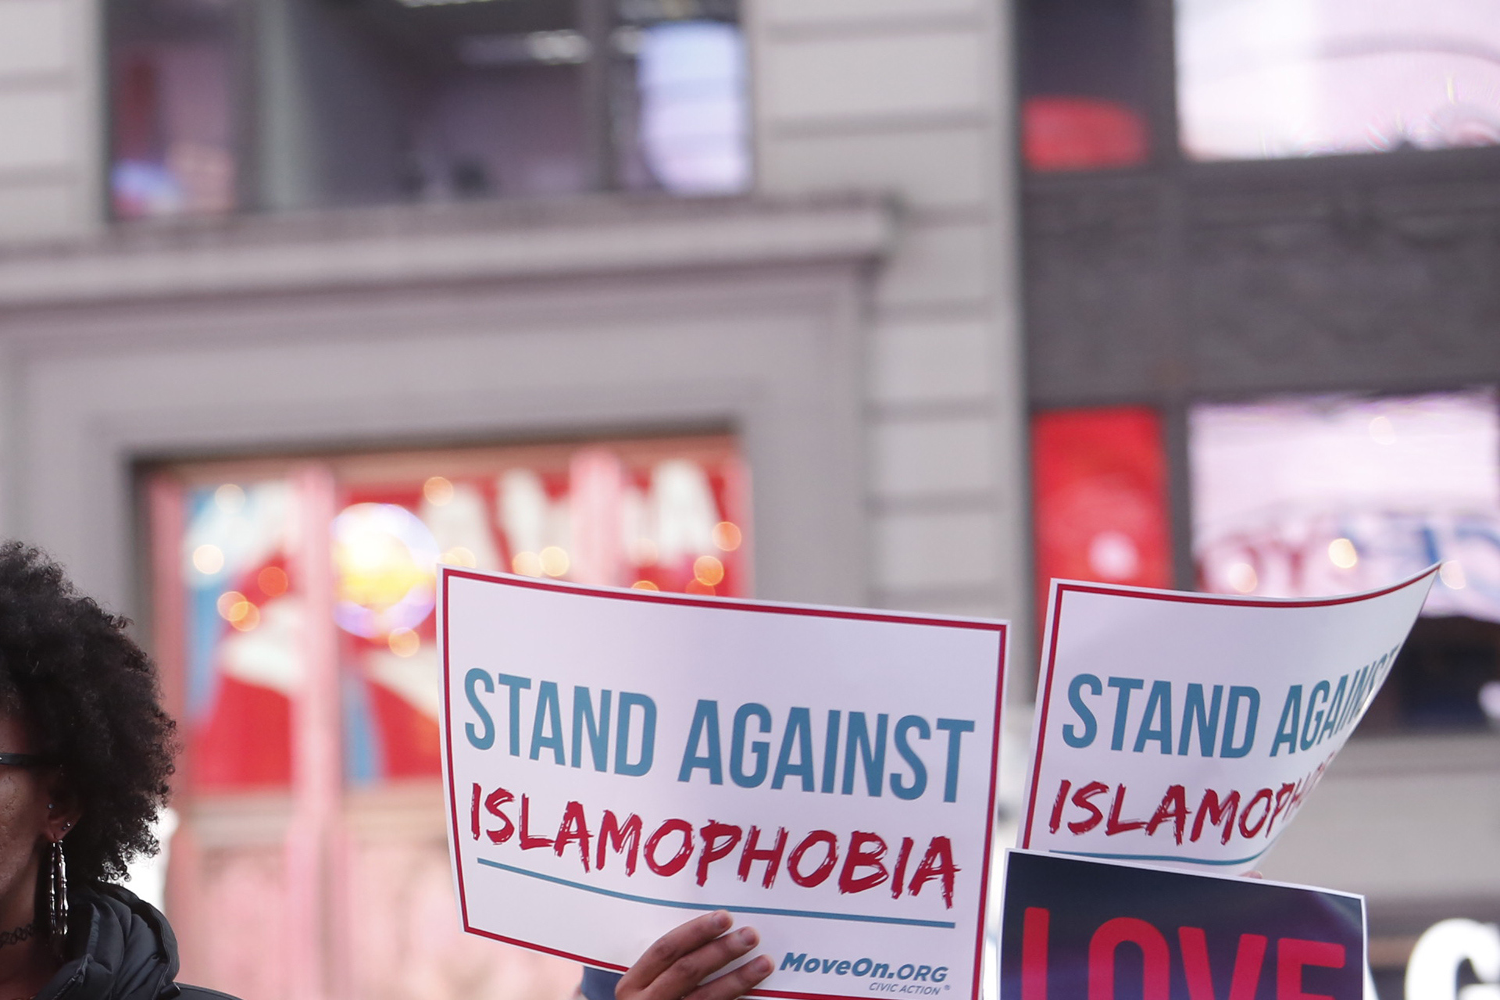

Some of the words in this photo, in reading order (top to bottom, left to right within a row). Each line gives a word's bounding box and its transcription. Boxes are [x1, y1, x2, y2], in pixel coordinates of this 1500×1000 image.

[464, 667, 658, 777] STAND
[677, 698, 975, 803] AGAINST
[1062, 673, 1260, 758] STAND
[470, 782, 961, 910] ISLAMOPHOBIA
[779, 952, 949, 983] MoveOn.ORG
[868, 981, 898, 993] CIVIC
